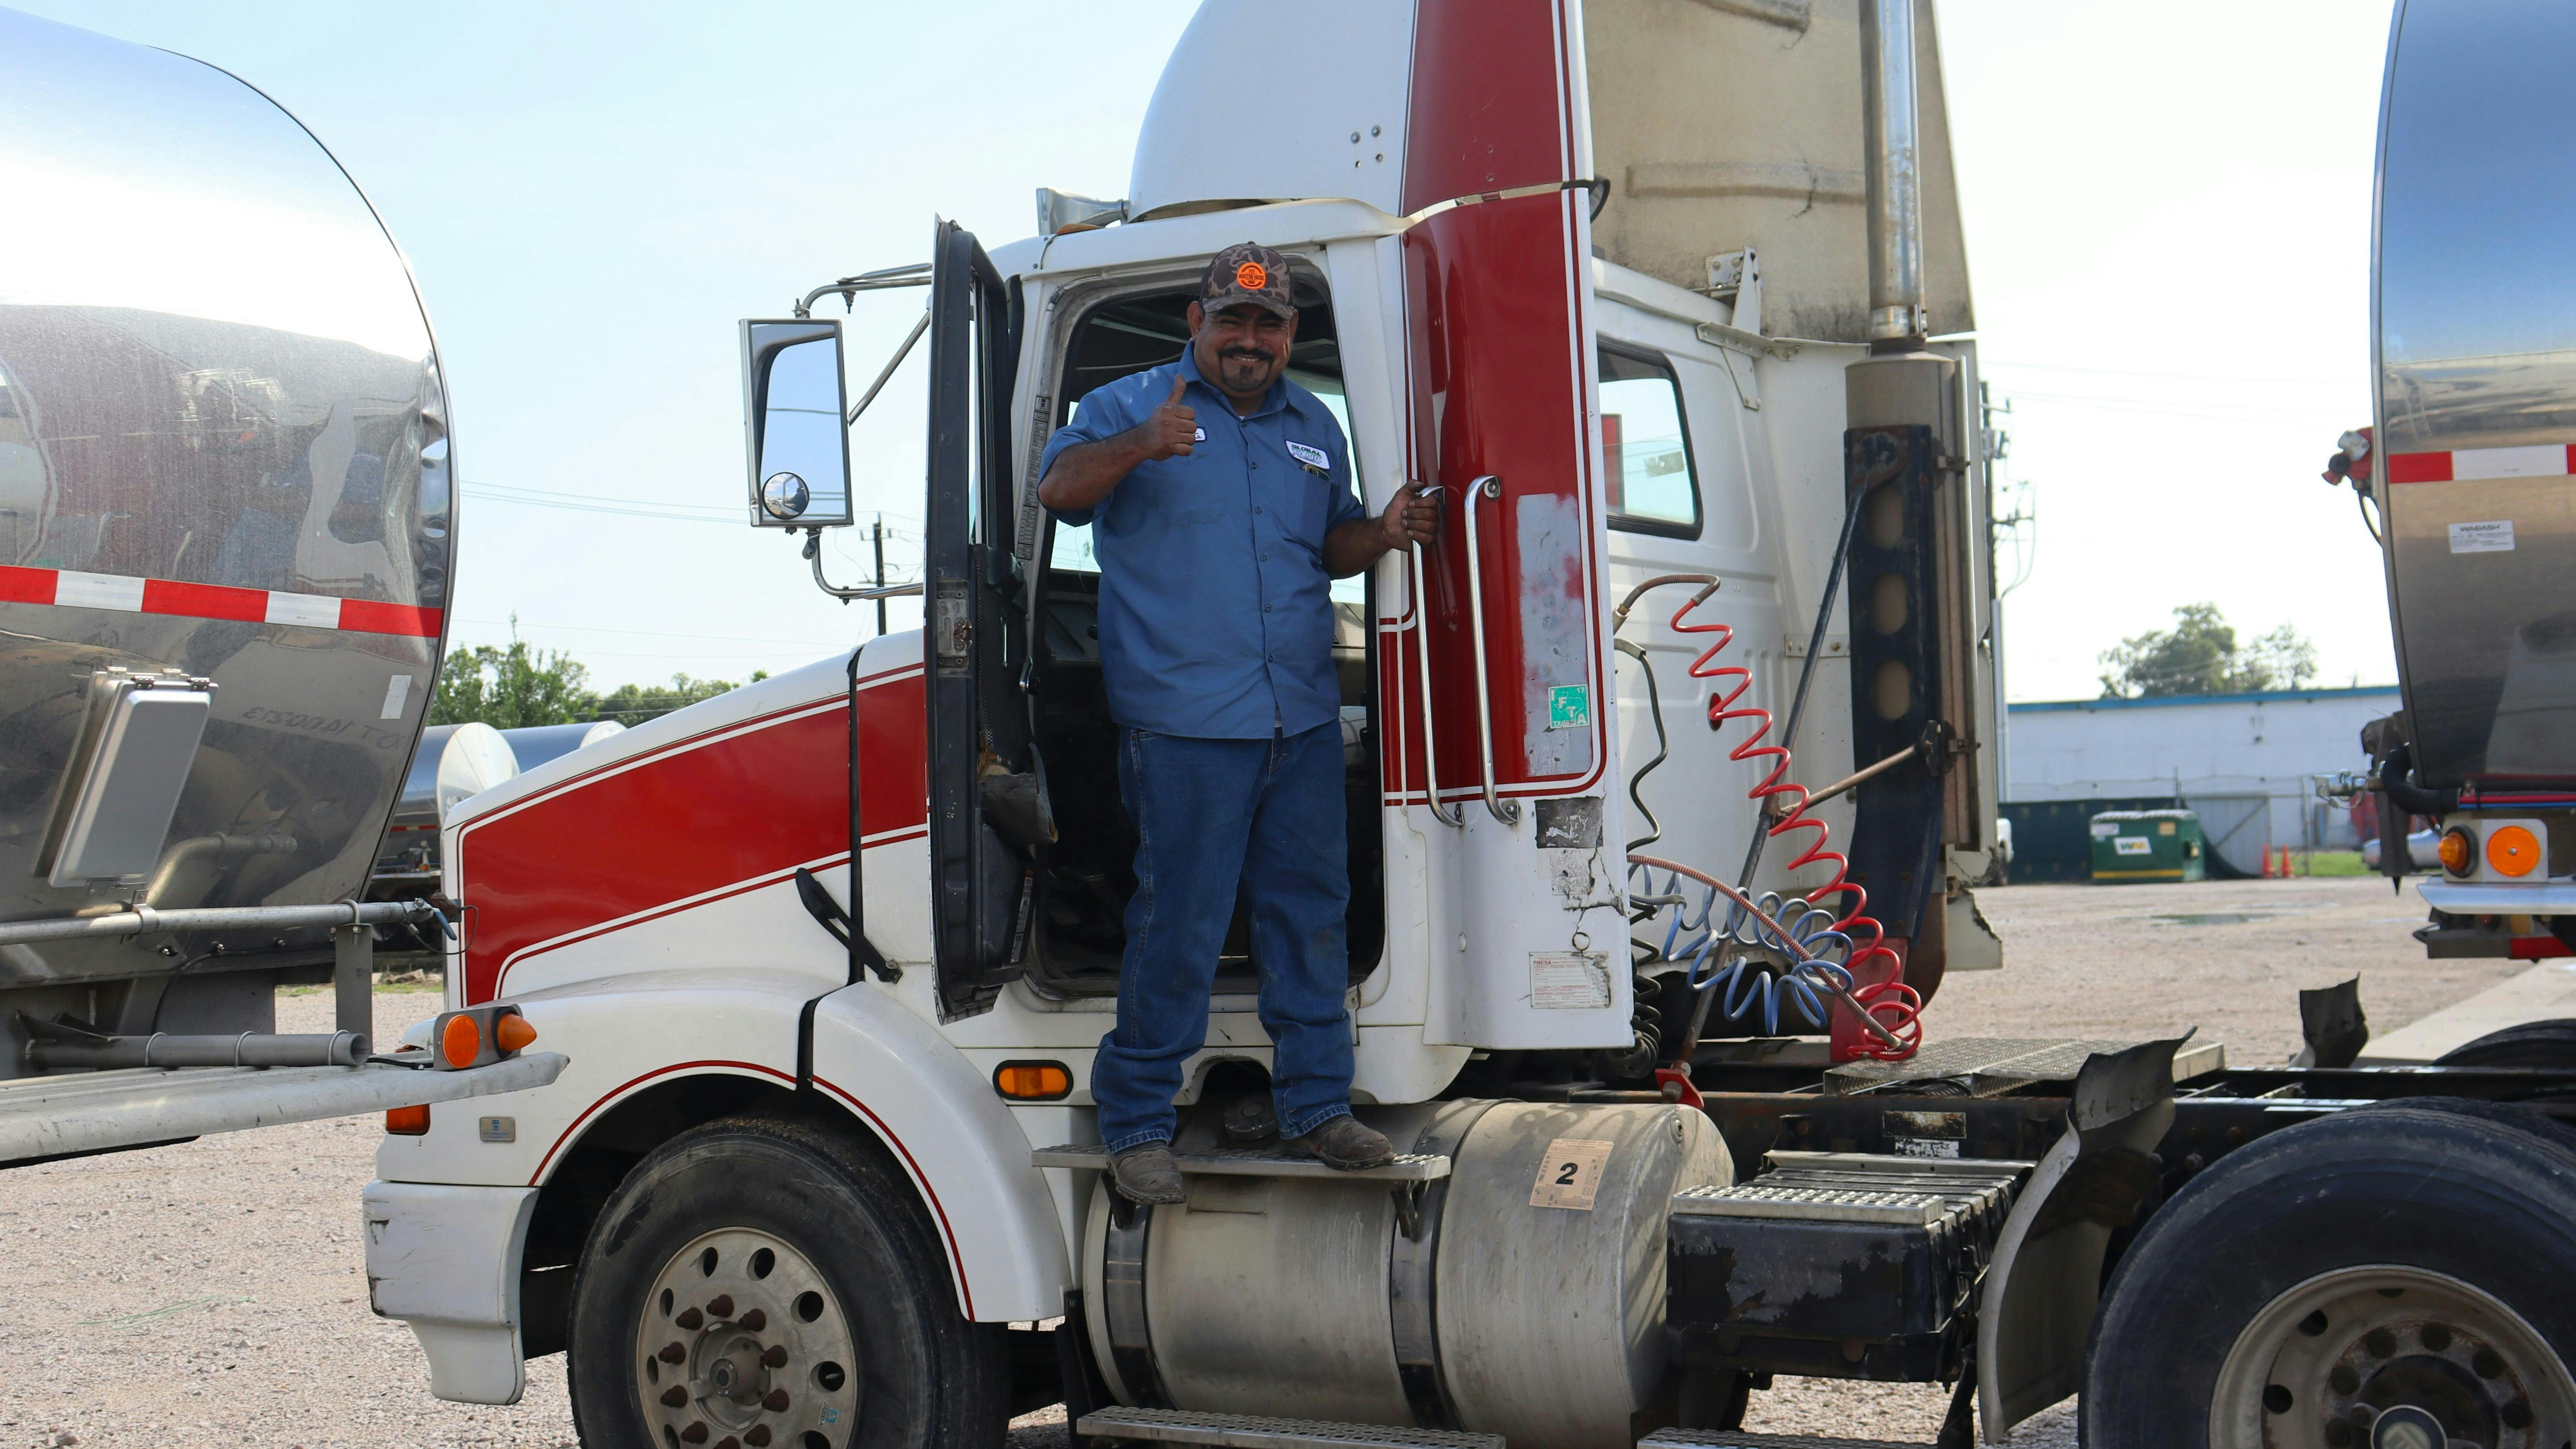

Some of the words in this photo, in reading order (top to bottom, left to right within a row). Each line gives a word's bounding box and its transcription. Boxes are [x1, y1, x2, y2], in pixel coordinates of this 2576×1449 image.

[1291, 444, 1320, 456] GLOBAL
[1293, 449, 1323, 463] TANK
[1555, 1162, 1578, 1185] 2
